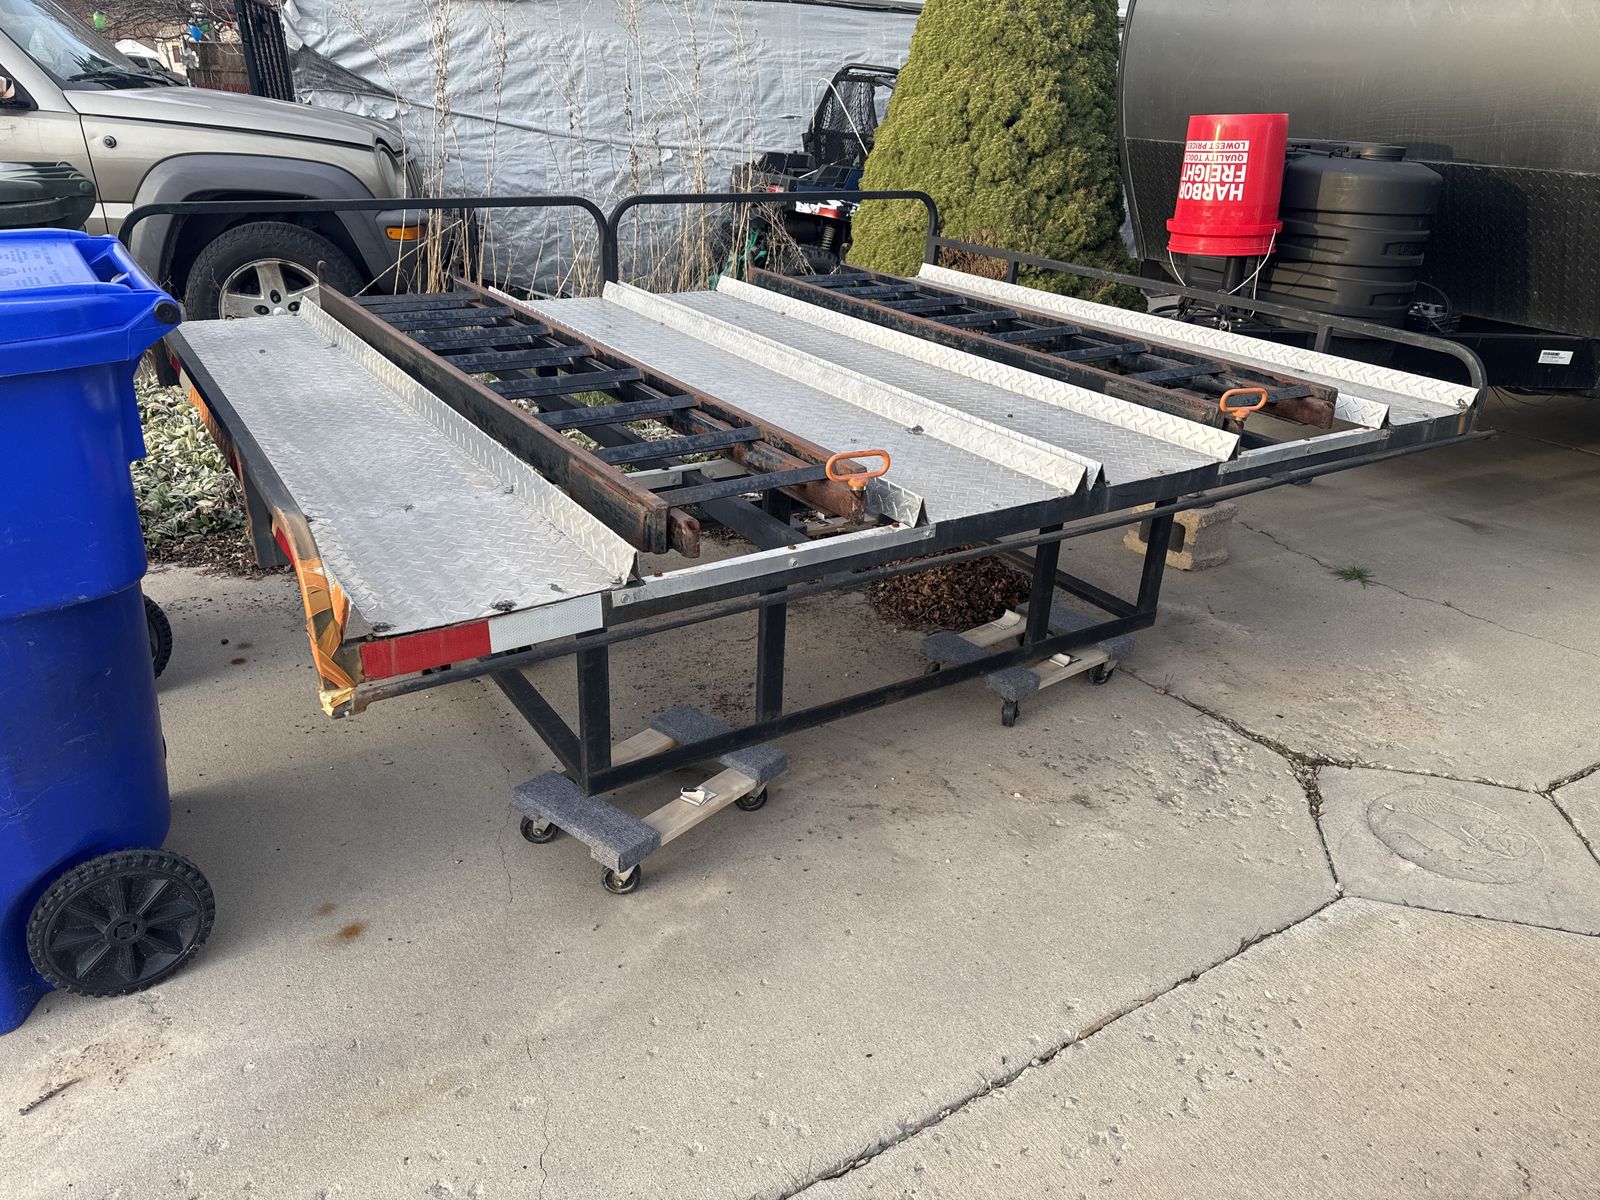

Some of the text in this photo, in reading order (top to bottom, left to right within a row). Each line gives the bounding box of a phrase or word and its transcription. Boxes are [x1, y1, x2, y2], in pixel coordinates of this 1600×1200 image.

[1208, 142, 1246, 150] LOWEST
[1204, 154, 1244, 162] QUALITY
[1182, 164, 1247, 182] FREIGHT
[1179, 183, 1244, 201] HARBOR
